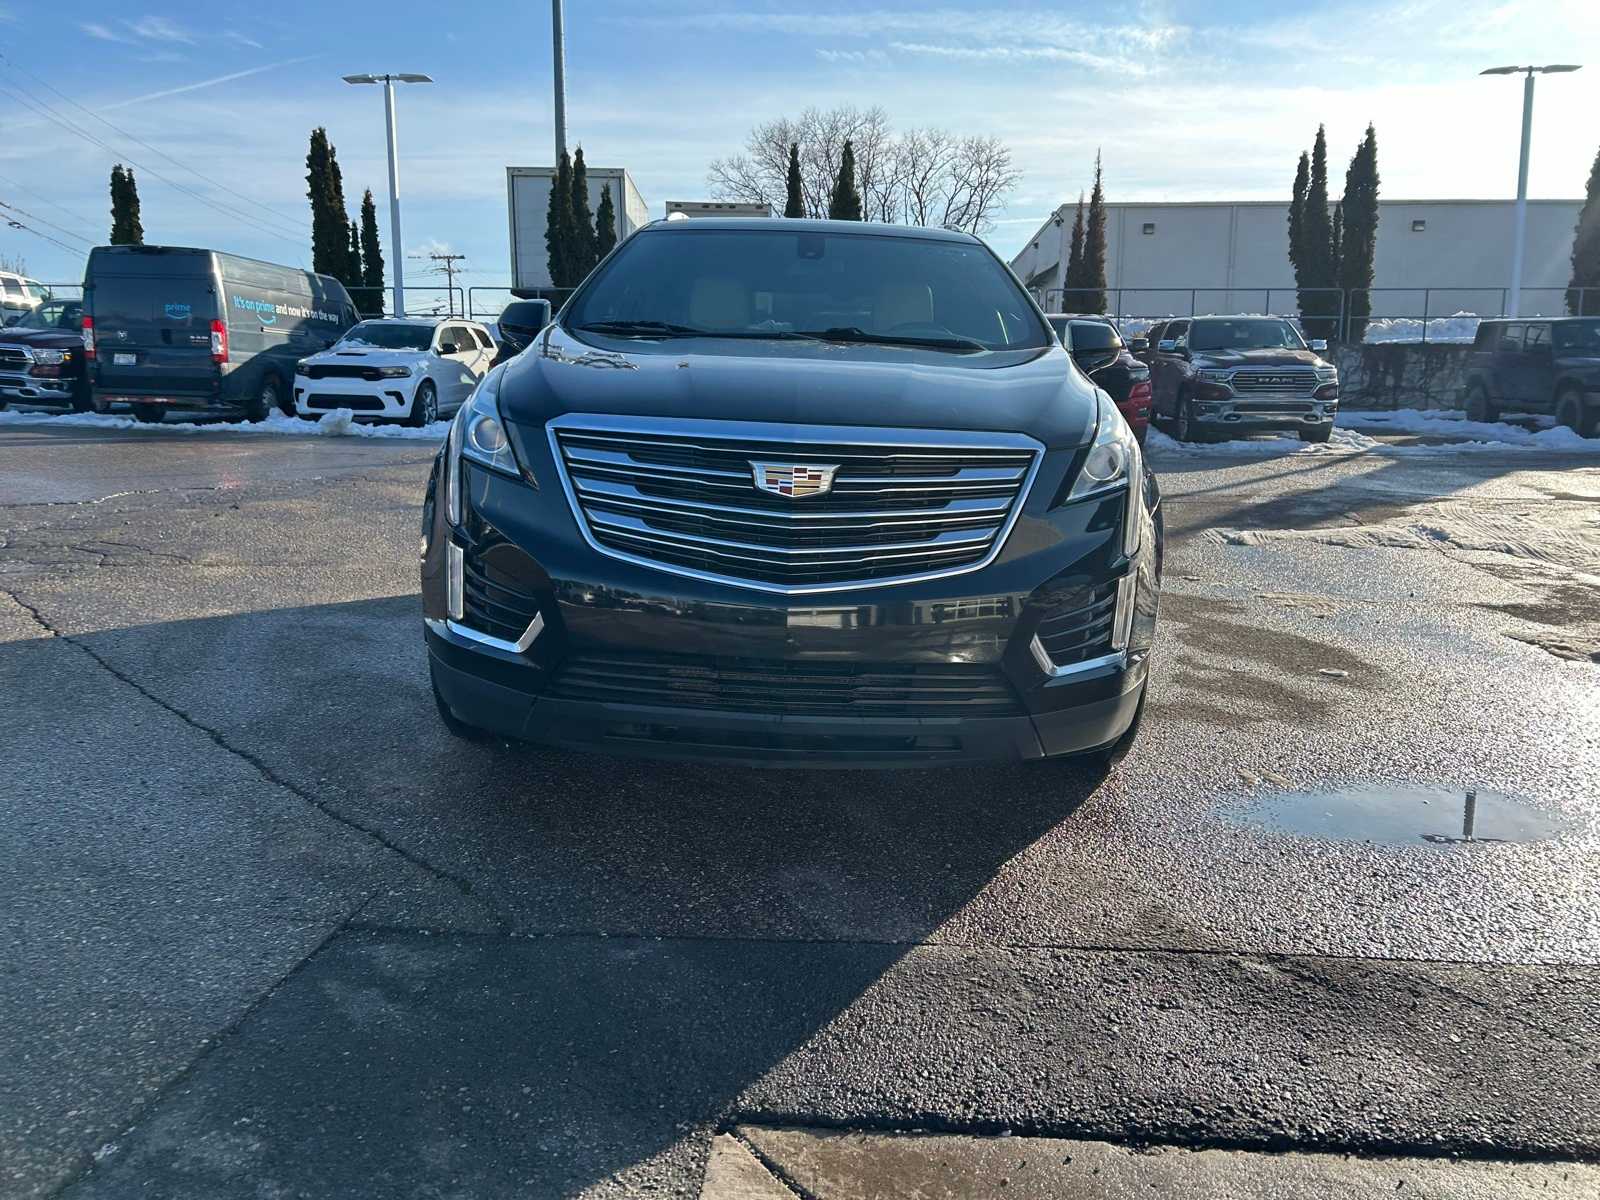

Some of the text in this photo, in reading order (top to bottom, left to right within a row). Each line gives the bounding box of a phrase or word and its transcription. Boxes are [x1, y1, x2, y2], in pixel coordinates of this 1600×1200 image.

[164, 302, 191, 313] prime
[245, 299, 255, 310] on
[256, 299, 275, 313] prime
[275, 303, 288, 315] and
[288, 306, 301, 317] now
[301, 305, 311, 318] it's
[311, 310, 319, 319] on
[319, 309, 328, 321] the
[328, 313, 339, 325] way
